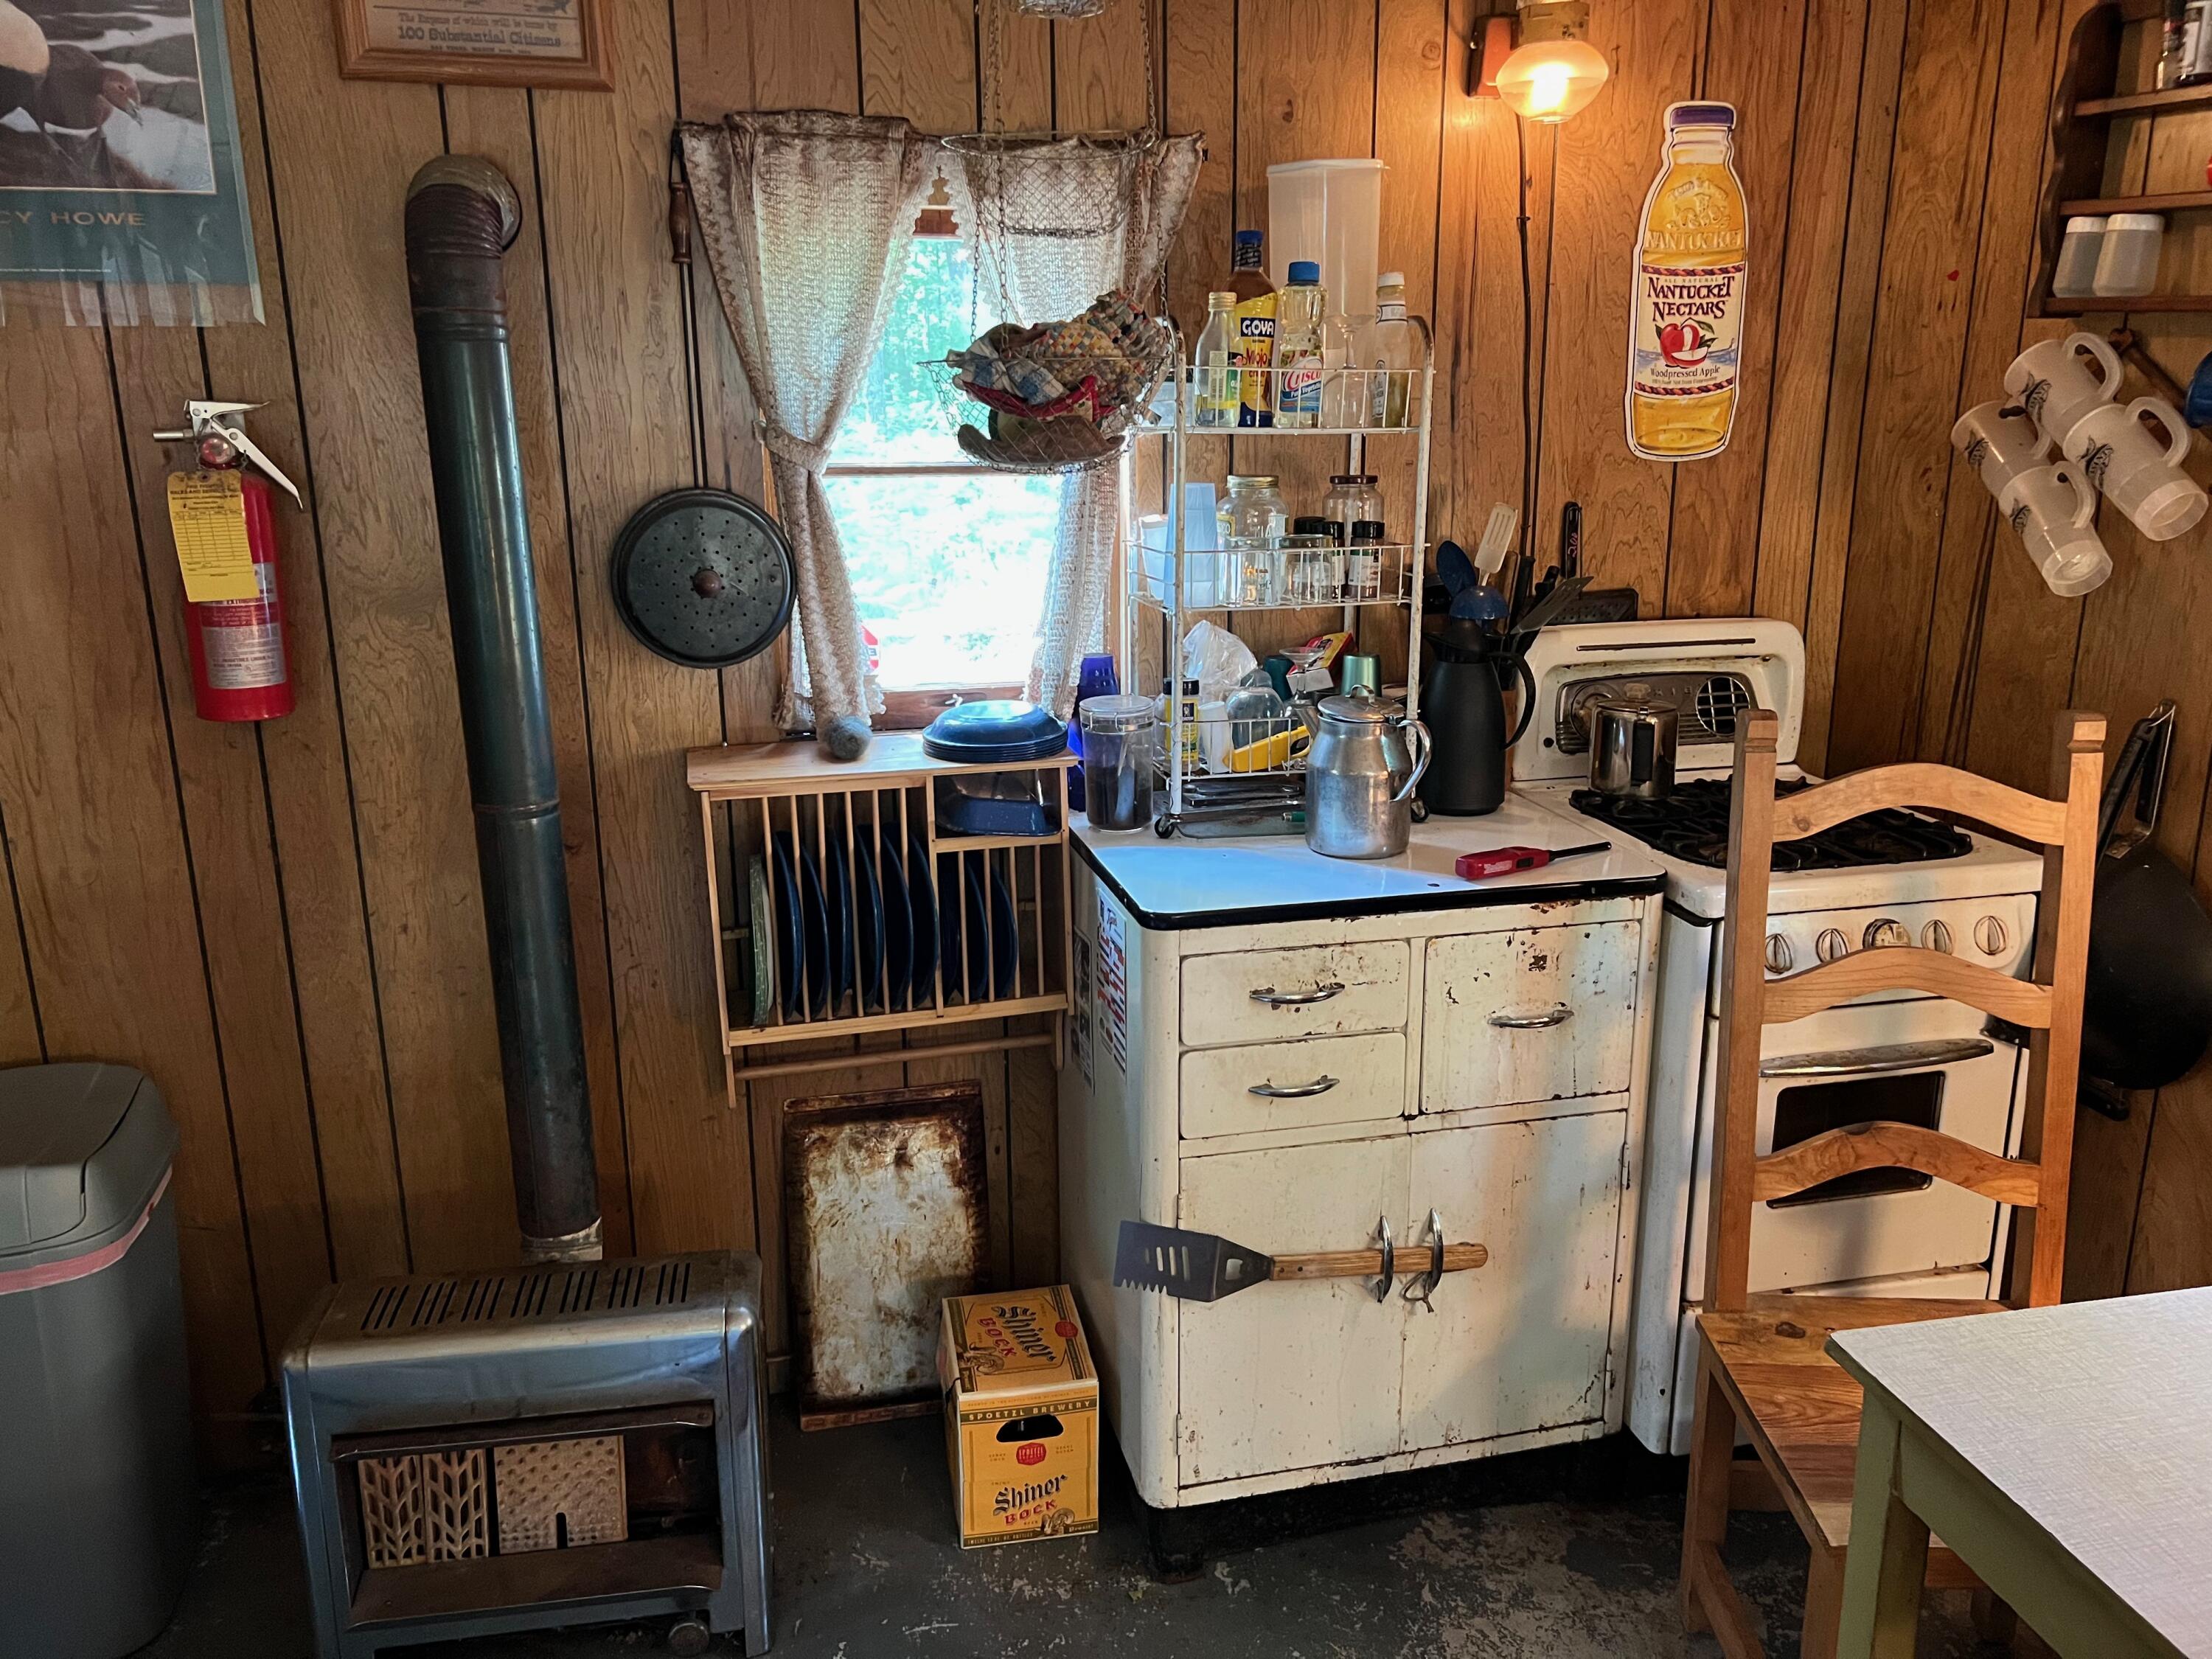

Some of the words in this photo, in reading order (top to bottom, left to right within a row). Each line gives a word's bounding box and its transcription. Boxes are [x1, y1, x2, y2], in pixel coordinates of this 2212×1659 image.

[398, 25, 425, 40] 100
[428, 27, 506, 44] Substantial
[509, 31, 561, 47] Citizens
[50, 211, 146, 226] HOWE
[1645, 229, 1742, 251] NANTUCKET
[1647, 276, 1735, 299] NANTUCKET
[1652, 300, 1726, 321] NECTARS
[1242, 319, 1274, 336] GOYA
[1242, 347, 1267, 367] Mojo
[1650, 367, 1697, 380] Woodpressed
[1699, 364, 1721, 378] Apple
[977, 1317, 1018, 1357] BOCK
[991, 1305, 1057, 1362] Shiner
[969, 1411, 1025, 1421] SPOETZL
[1032, 1400, 1091, 1414] BREWERY
[993, 1474, 1068, 1516] Shiner
[1004, 1500, 1057, 1526] BOCK
